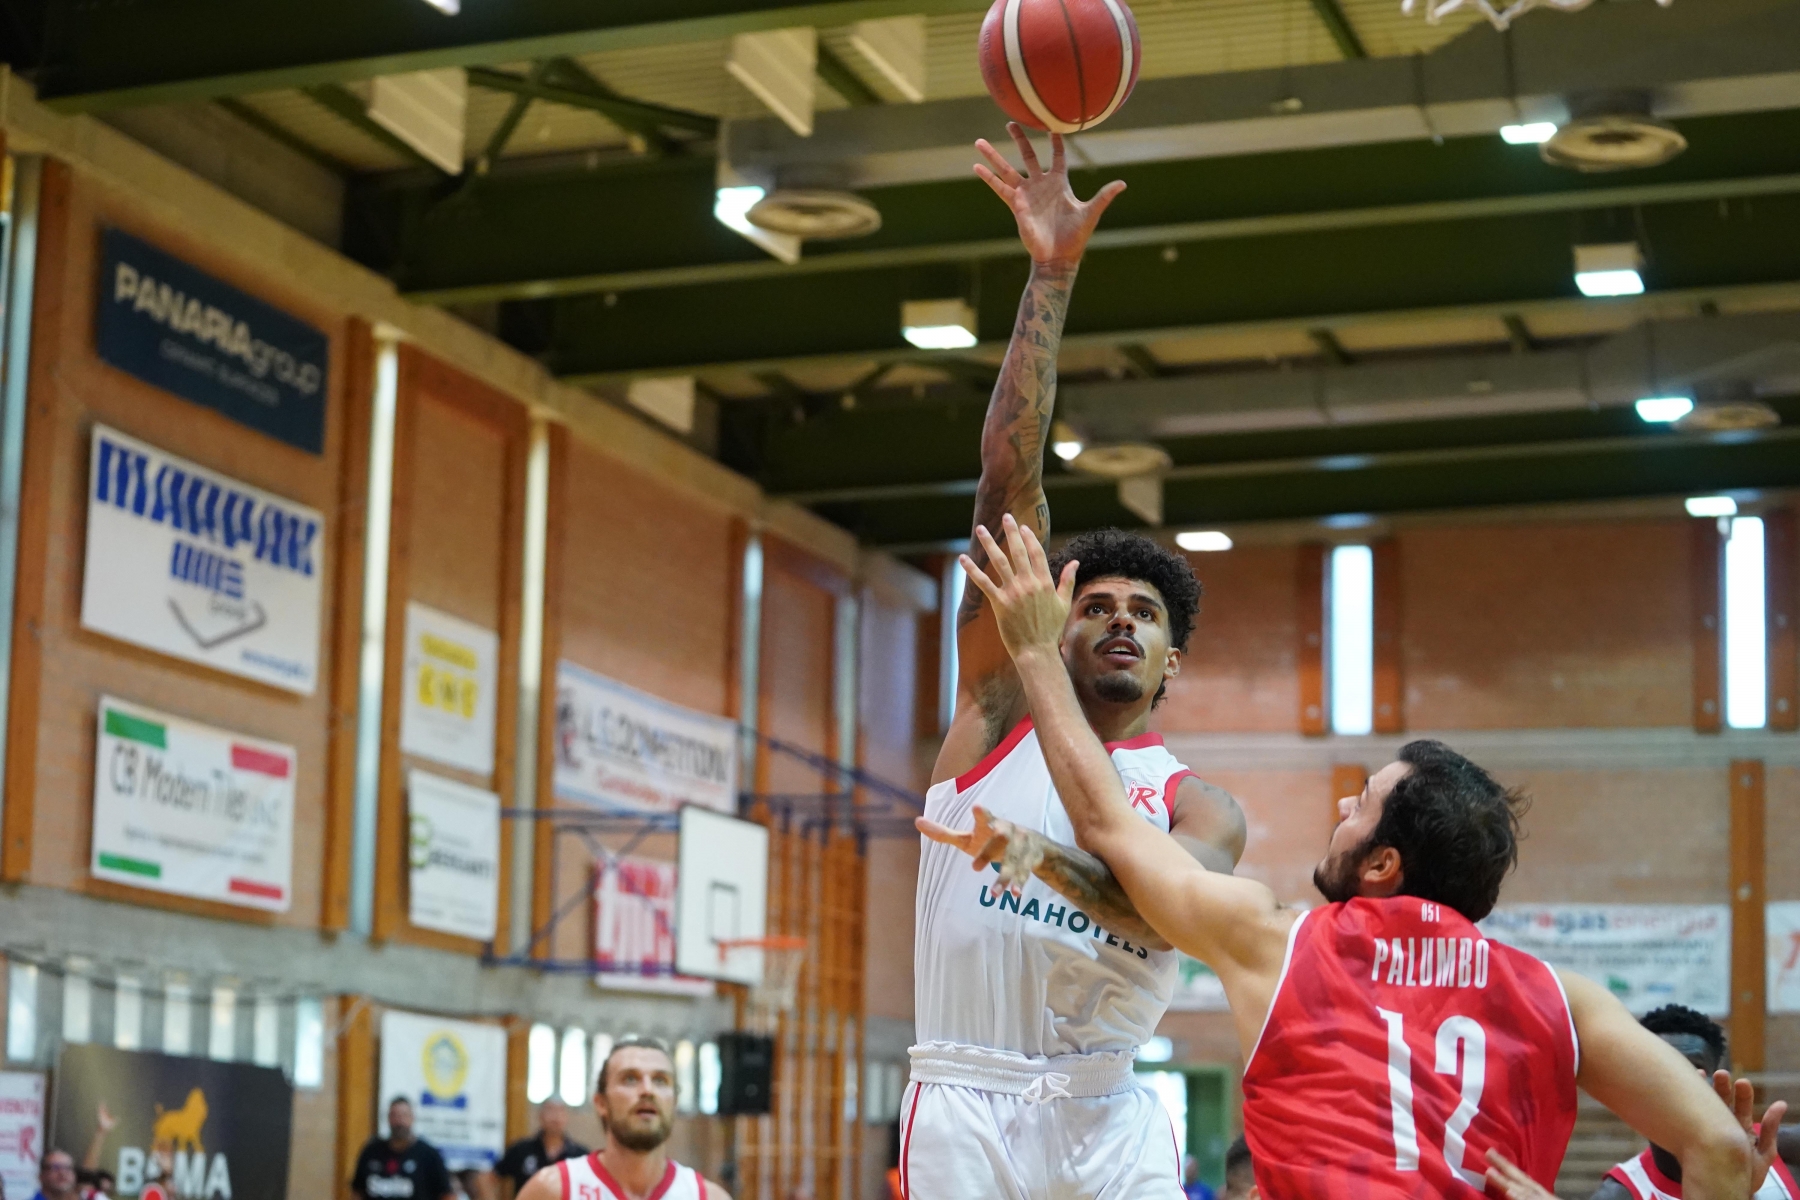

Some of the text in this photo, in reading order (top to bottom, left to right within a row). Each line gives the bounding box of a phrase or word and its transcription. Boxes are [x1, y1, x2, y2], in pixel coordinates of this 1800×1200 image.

[1421, 902, 1440, 923] 051
[1371, 936, 1490, 989] PALUMBO
[1376, 1005, 1486, 1192] 12
[579, 1184, 600, 1200] 51
